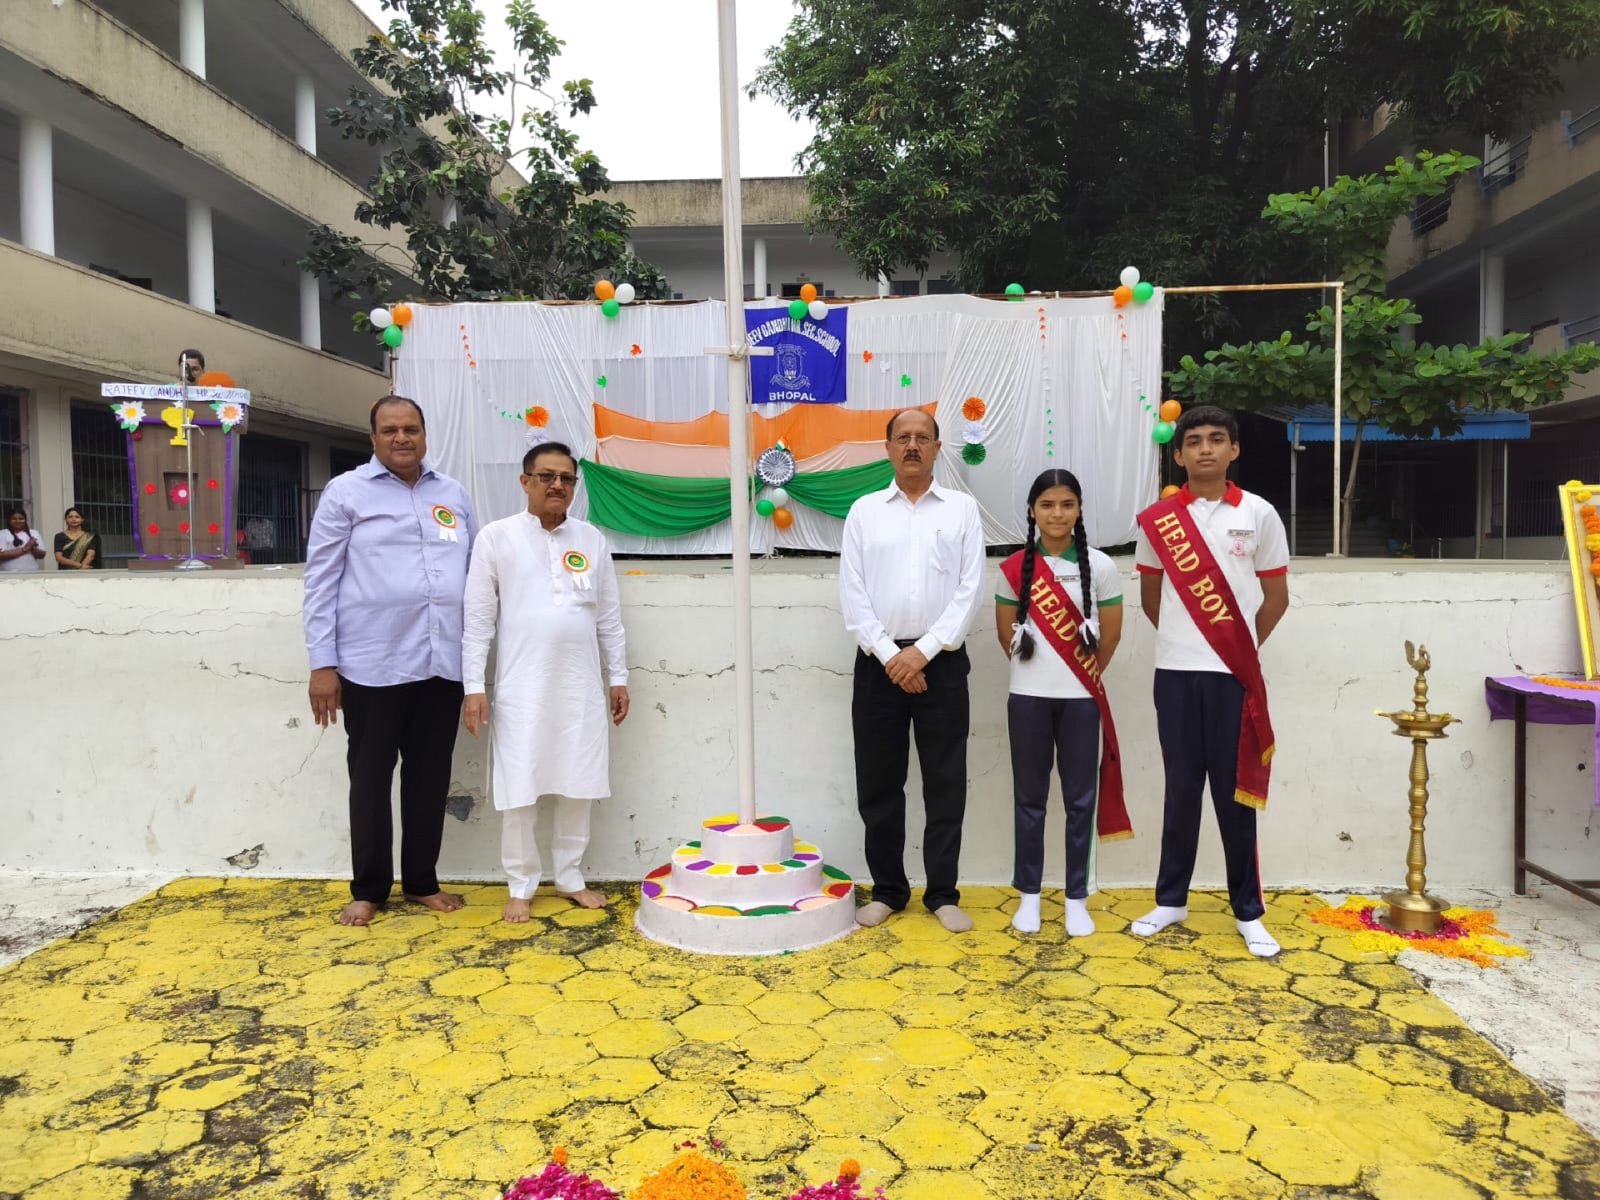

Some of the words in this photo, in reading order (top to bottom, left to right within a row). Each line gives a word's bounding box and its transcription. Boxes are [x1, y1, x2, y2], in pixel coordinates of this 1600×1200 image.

[817, 327, 841, 358] SCHOOL
[105, 384, 146, 397] RAJEEV
[150, 386, 184, 399] GANDH
[768, 390, 817, 401] BHOPAL
[1153, 511, 1201, 573] HEAD
[1187, 573, 1235, 626] BOY
[1029, 575, 1080, 642] HEAD
